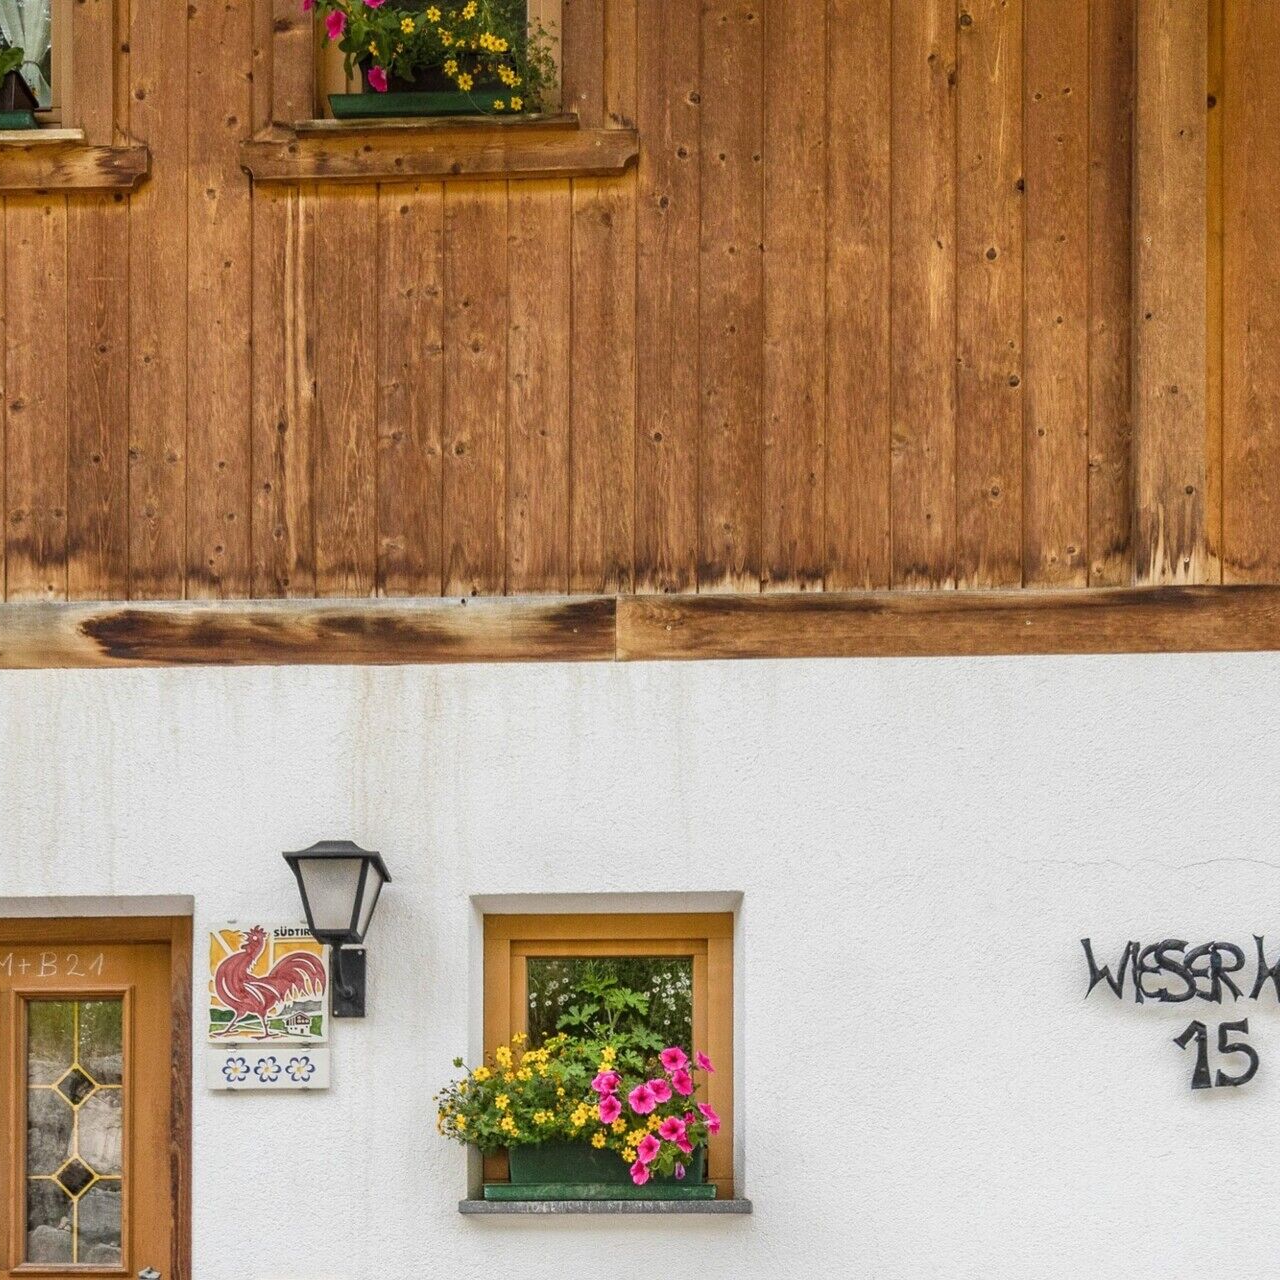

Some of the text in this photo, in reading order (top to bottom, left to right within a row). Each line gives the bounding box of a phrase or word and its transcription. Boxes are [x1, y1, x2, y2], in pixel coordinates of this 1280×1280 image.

[273, 926, 312, 937] SÜDTIR
[1080, 938, 1245, 1004] WIESER
[1172, 1017, 1260, 1089] 15
